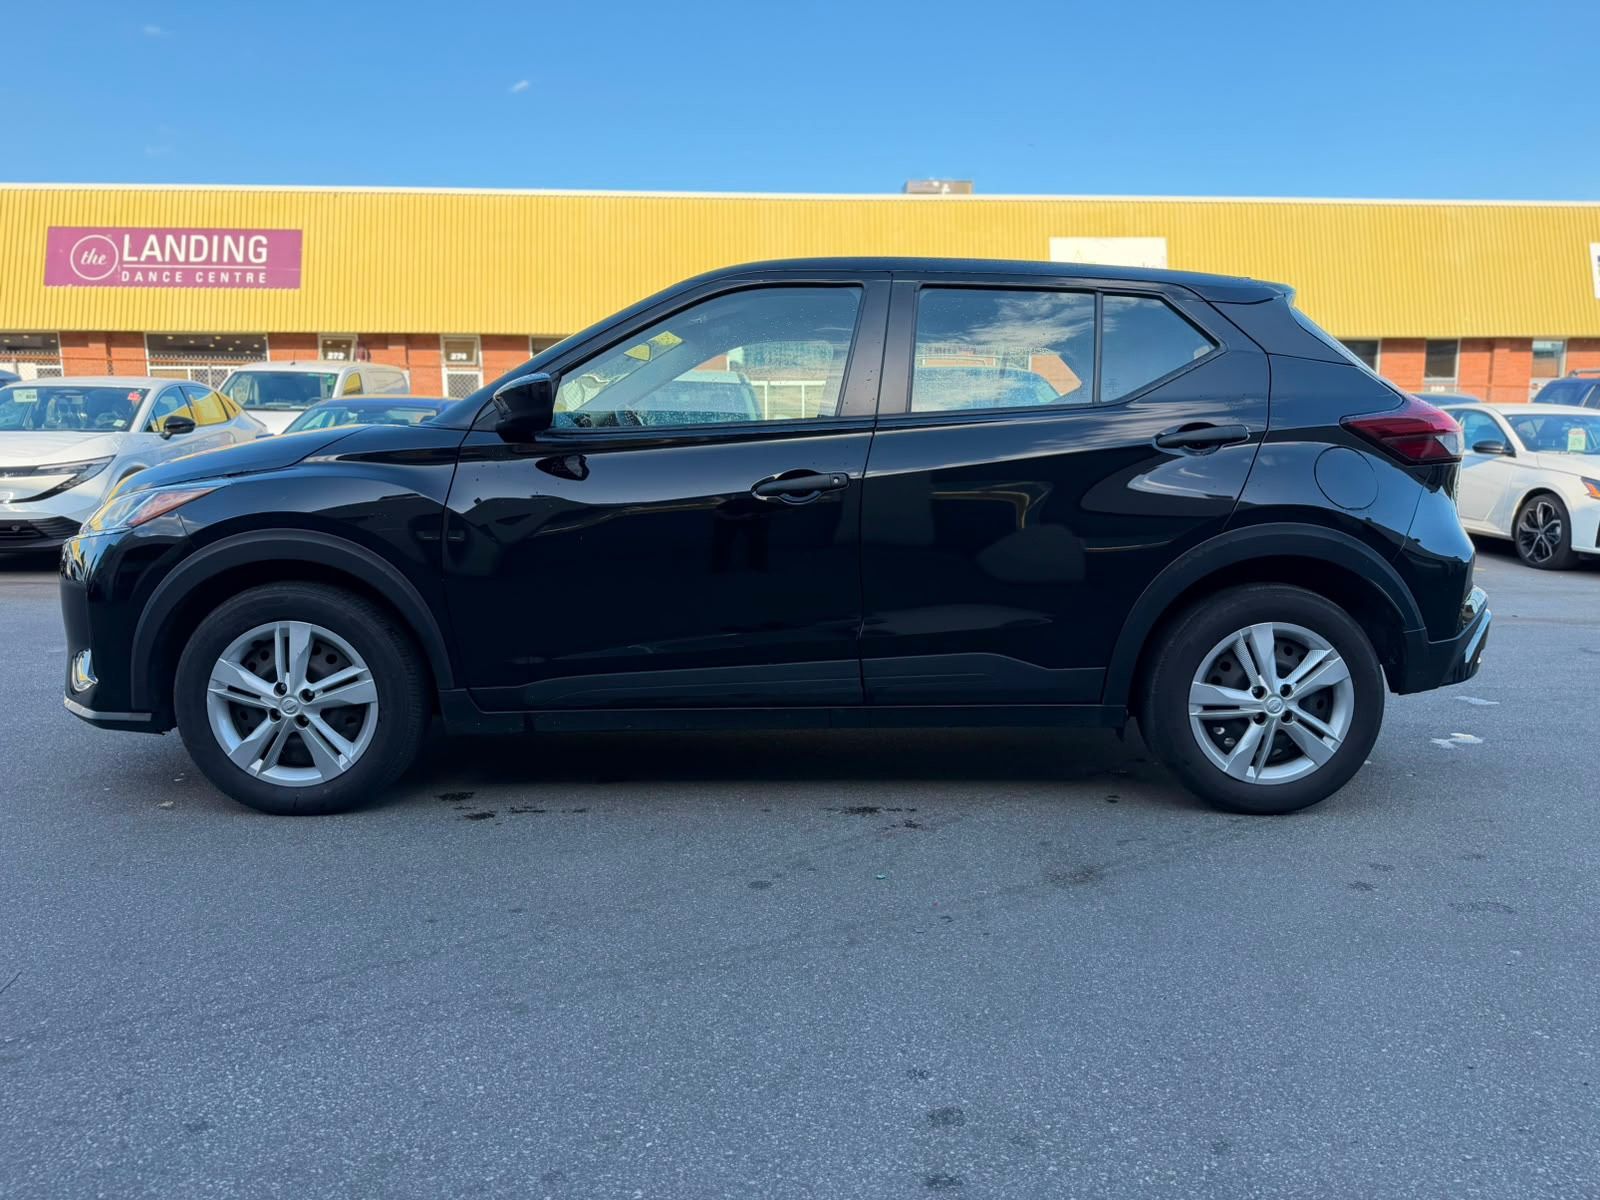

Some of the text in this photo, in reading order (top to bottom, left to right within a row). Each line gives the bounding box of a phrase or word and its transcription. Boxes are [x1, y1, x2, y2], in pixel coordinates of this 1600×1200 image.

[80, 233, 268, 266] the LANDING
[121, 271, 267, 284] DANCE CENTRE
